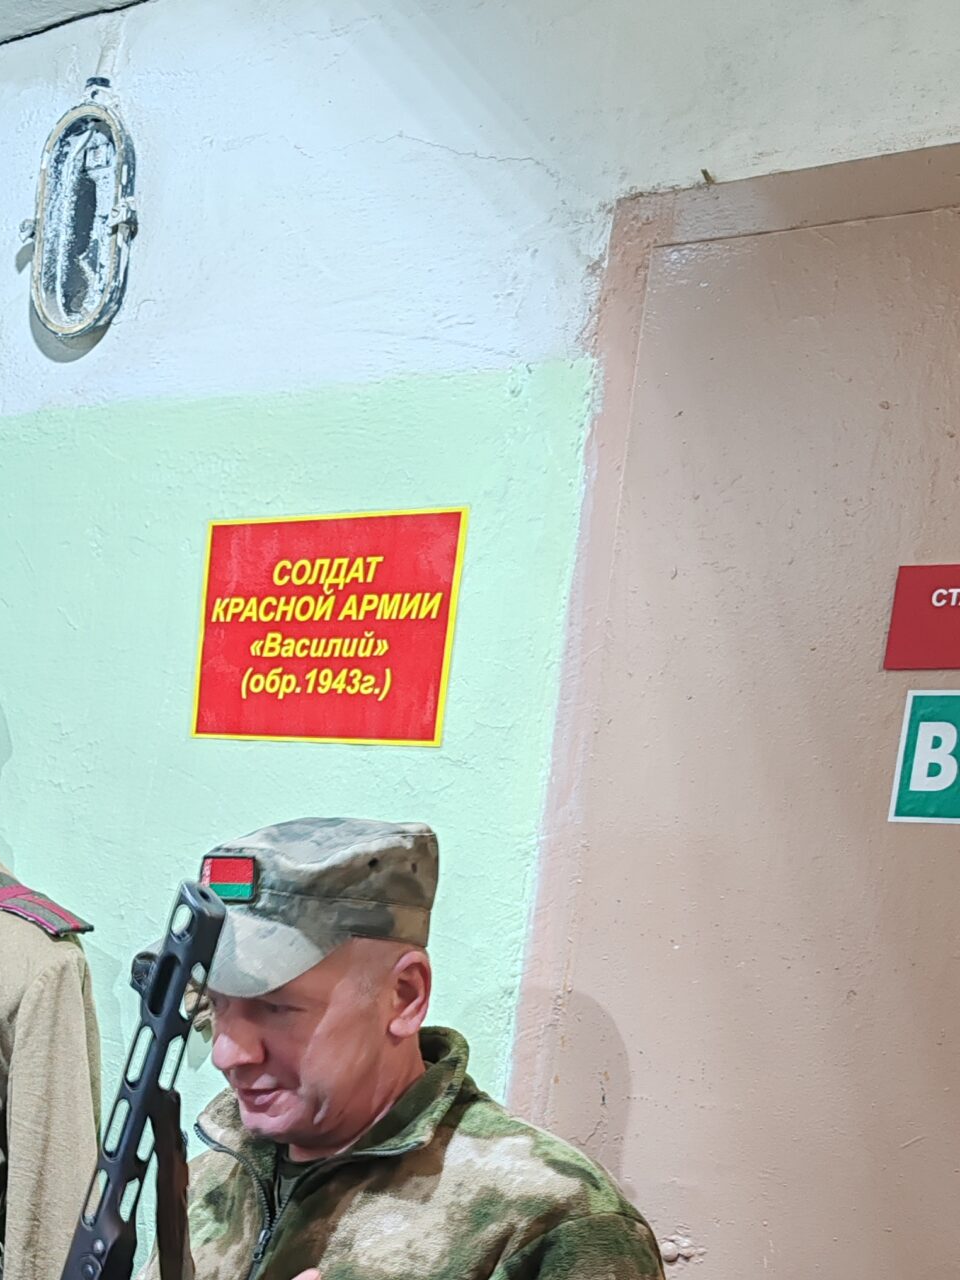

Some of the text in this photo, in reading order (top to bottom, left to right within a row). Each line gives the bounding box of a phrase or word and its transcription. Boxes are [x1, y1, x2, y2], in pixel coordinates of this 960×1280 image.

[272, 556, 384, 590] СОЛДАТ
[211, 588, 443, 623] КРАСНОЙ АРМИИ
[931, 588, 960, 607] СТ
[249, 630, 390, 658] «Василий»
[240, 666, 392, 701] (обр.1943г.)
